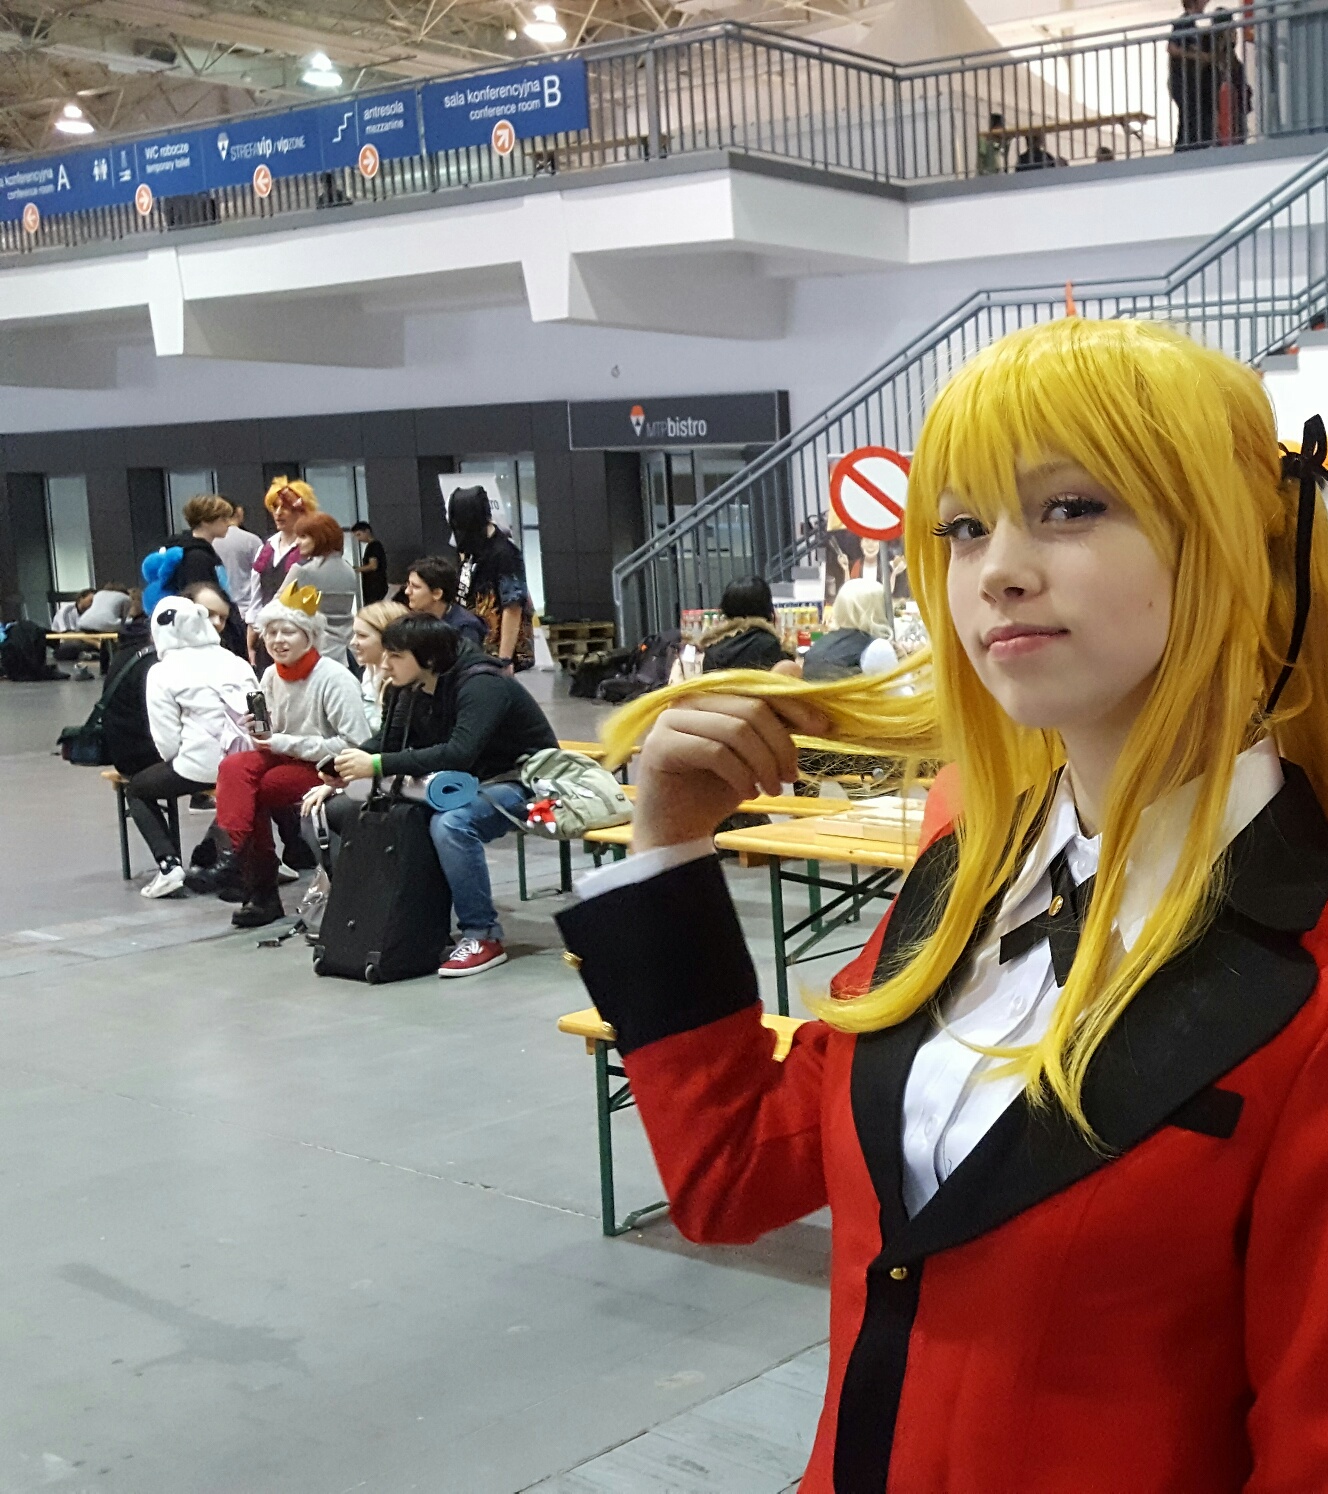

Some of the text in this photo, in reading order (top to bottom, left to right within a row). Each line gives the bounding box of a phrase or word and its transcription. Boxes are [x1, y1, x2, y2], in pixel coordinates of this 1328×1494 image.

[444, 75, 561, 108] sala konferencyjna B
[363, 100, 404, 120] antresola
[469, 99, 541, 120] conference room
[144, 145, 159, 160] WC
[57, 163, 71, 191] A
